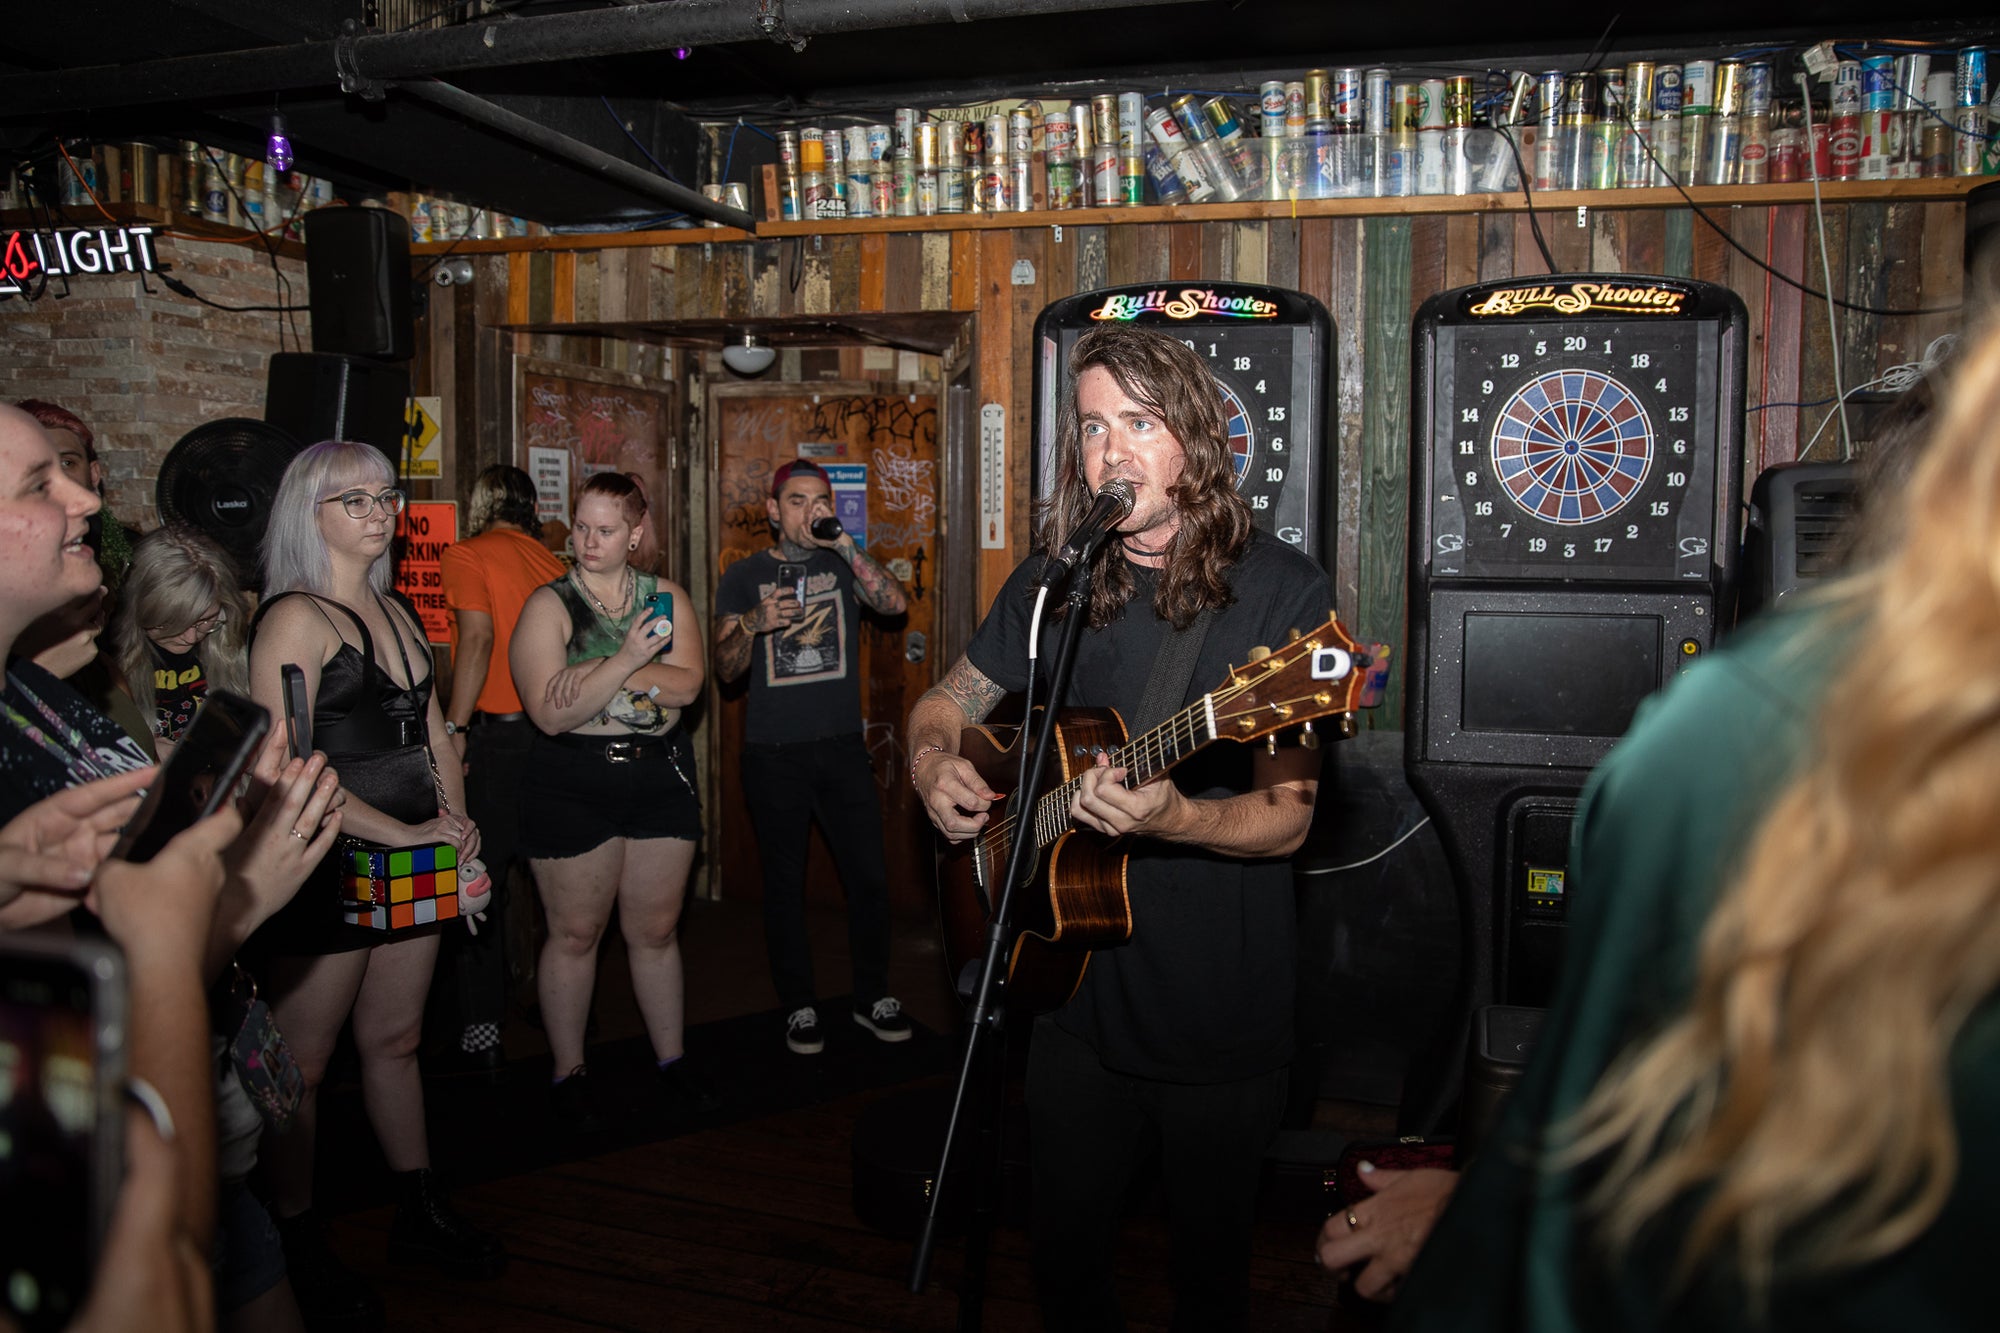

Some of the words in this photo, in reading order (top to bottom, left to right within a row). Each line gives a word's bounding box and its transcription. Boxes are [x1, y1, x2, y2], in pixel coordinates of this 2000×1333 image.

[940, 109, 970, 121] BEER
[817, 199, 847, 211] 24K
[33, 227, 152, 275] LIGHT
[1165, 289, 1278, 319] Shooter
[1553, 284, 1685, 314] Shooter
[1210, 344, 1217, 357] 1
[1535, 341, 1546, 355] 5
[1564, 337, 1586, 351] 20
[1604, 340, 1612, 354] 1
[1234, 357, 1250, 370] 18
[1502, 354, 1519, 368] 12
[1631, 354, 1649, 368] 18
[1256, 380, 1266, 393] 4
[1483, 380, 1493, 394] 9
[1655, 378, 1667, 392] 4
[1268, 407, 1285, 420] 13
[1461, 408, 1478, 422] 14
[1669, 407, 1688, 421] 13
[1272, 438, 1282, 451] 6
[1459, 441, 1474, 454] 11
[1674, 440, 1685, 453] 6
[836, 470, 864, 481] Spread
[1267, 468, 1283, 481] 10
[1466, 472, 1477, 485] 8
[1667, 472, 1685, 486] 10
[1252, 496, 1268, 509] 15
[1475, 502, 1492, 515] 16
[1651, 502, 1668, 516] 15
[409, 516, 429, 535] NO
[1501, 524, 1512, 537] 7
[1627, 525, 1638, 538] 2
[403, 542, 449, 561] RKIN
[1529, 538, 1546, 552] 19
[1564, 544, 1575, 557] 3
[1595, 539, 1612, 552] 17
[421, 571, 441, 587] SID
[410, 593, 445, 609] STREE
[1311, 647, 1351, 681] D
